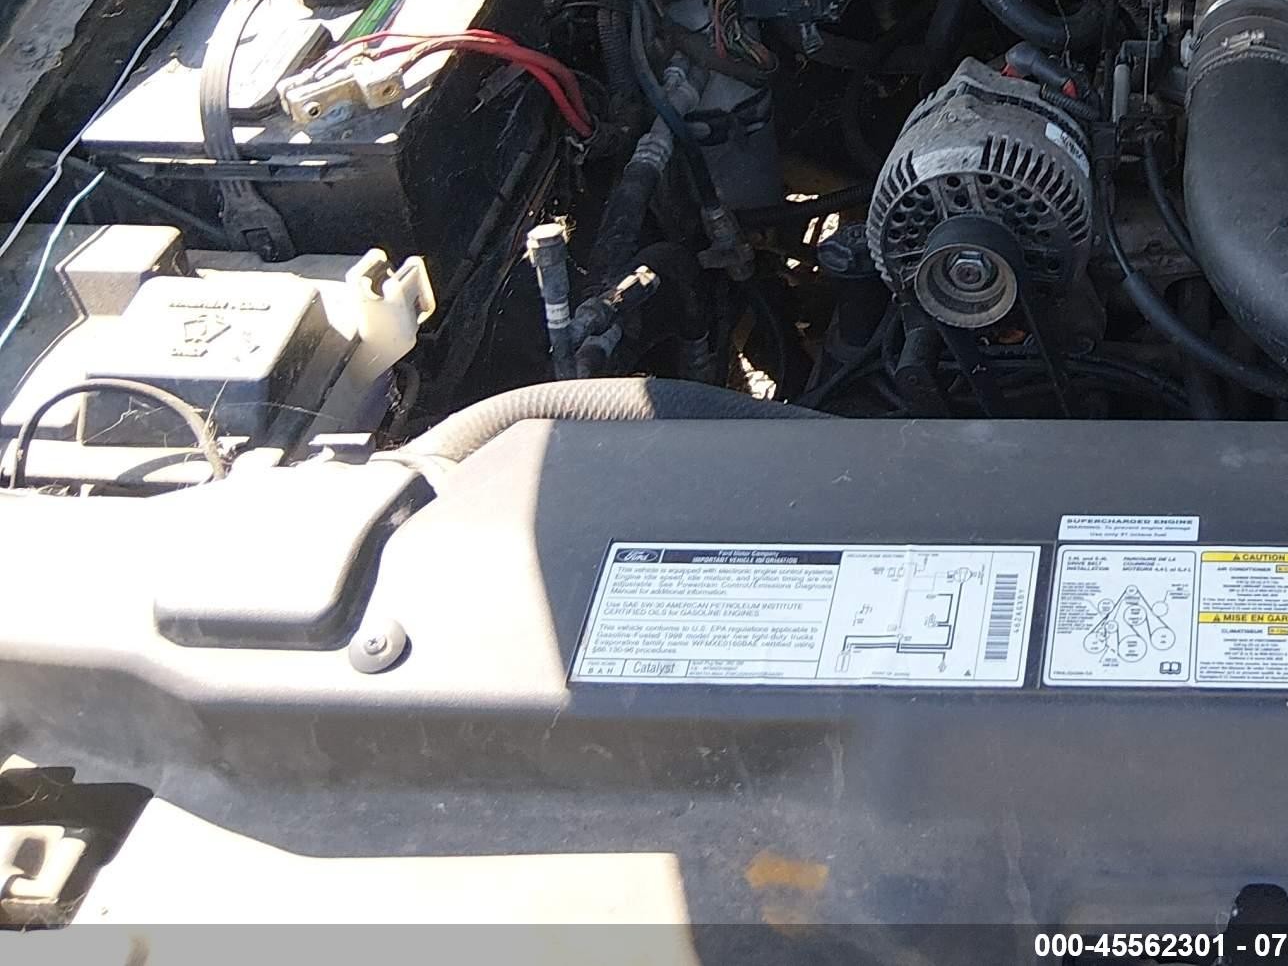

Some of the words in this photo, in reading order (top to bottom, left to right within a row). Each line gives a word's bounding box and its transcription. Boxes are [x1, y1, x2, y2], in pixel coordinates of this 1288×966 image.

[1241, 553, 1286, 561] CAUTION
[1223, 614, 1249, 622] MISE
[632, 661, 676, 676] Catalyst
